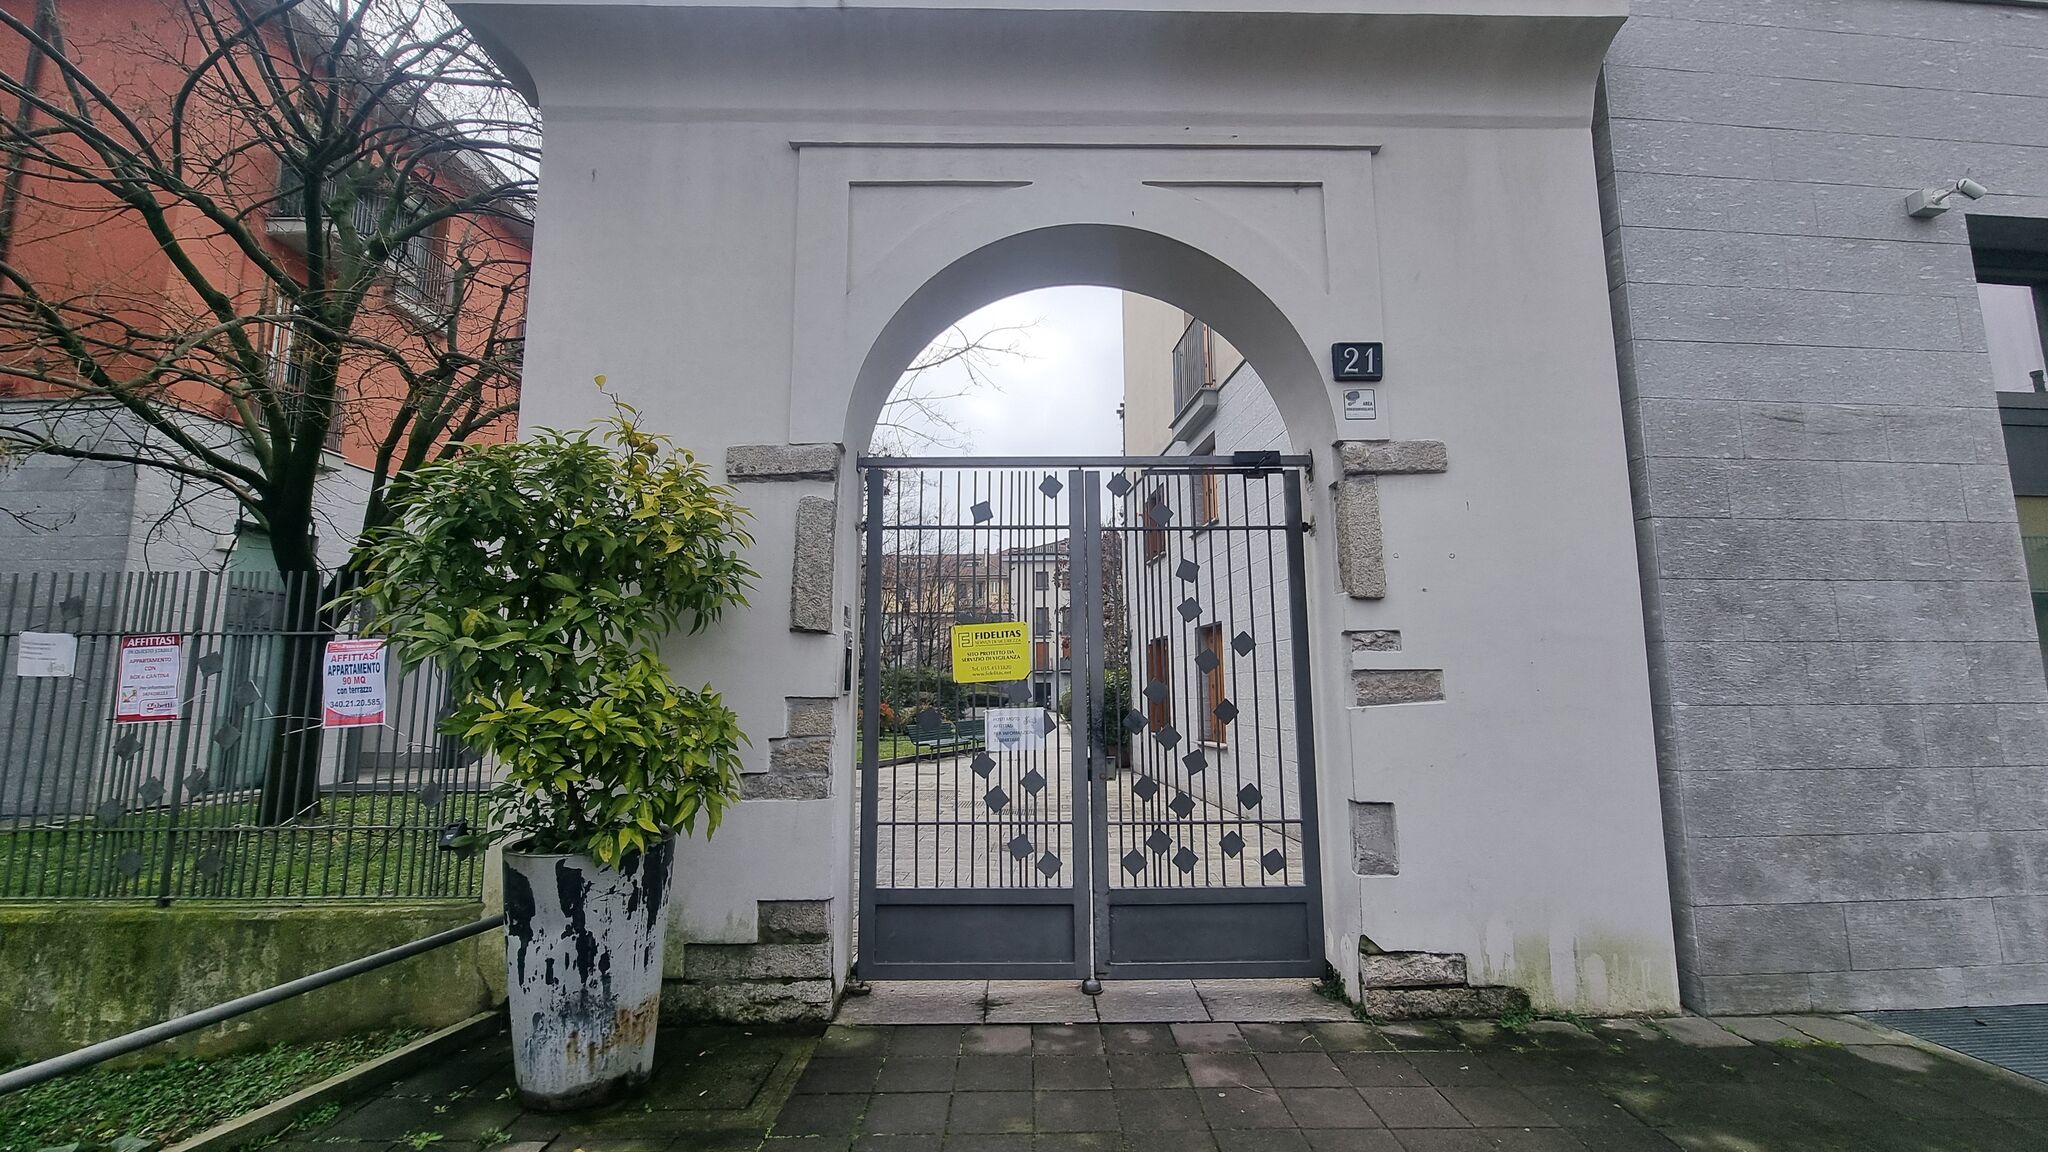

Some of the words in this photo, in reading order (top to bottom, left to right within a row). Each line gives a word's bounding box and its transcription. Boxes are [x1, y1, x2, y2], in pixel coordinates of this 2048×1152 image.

[1343, 347, 1374, 374] 21
[975, 629, 1021, 640] FIDELITAS
[127, 636, 175, 647] AFFITTASI
[331, 652, 379, 662] AFFITTASI
[328, 662, 381, 676] APPARTAMENTO
[342, 676, 352, 685] 90
[354, 675, 366, 684] MQ
[349, 686, 372, 694] terrazzo
[330, 698, 381, 708] 340.21.20.585
